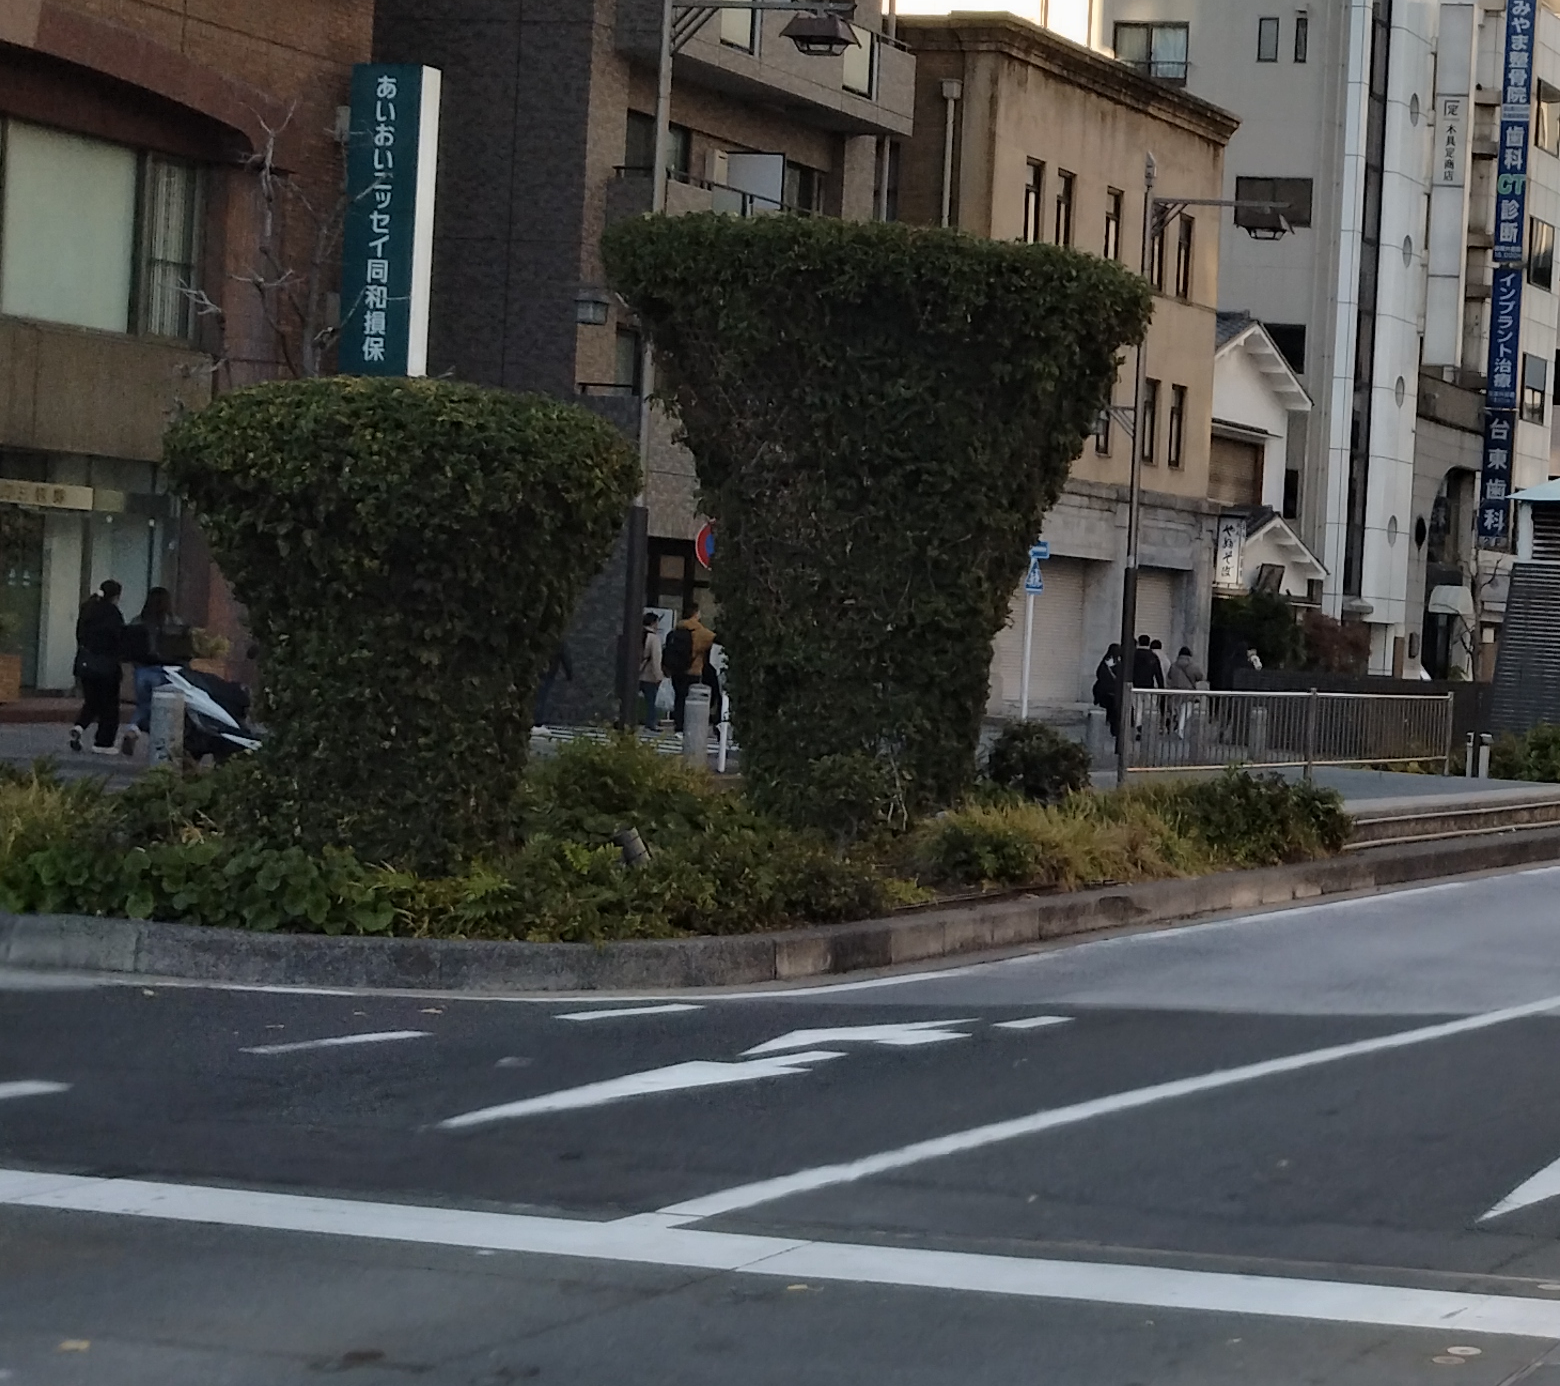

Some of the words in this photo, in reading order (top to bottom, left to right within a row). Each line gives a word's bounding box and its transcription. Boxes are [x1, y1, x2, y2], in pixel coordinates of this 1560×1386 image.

[362, 75, 397, 362] あいおいニッセイ同和損保
[1493, 273, 1516, 388] インプラント治療
[1483, 417, 1510, 532] 台東歯科
